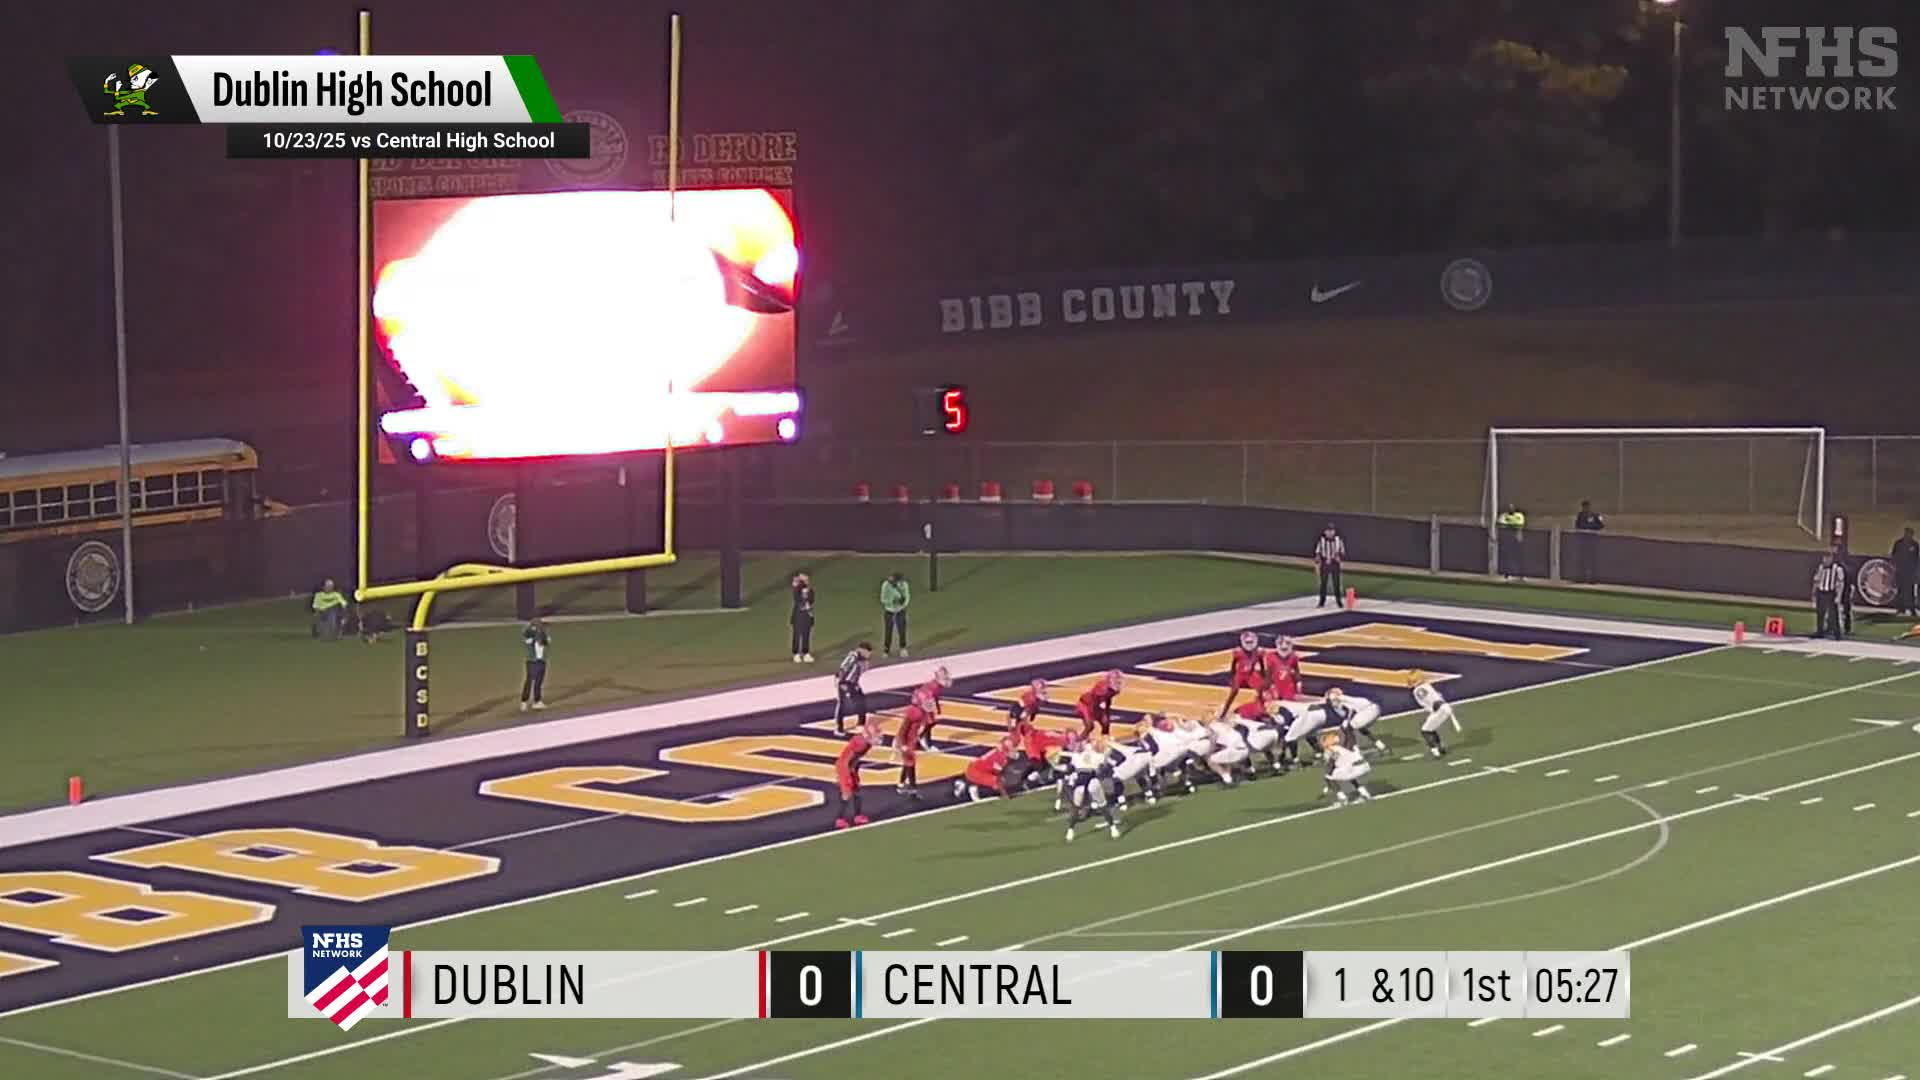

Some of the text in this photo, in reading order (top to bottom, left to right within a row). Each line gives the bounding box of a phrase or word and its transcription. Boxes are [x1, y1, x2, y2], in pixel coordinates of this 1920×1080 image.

[694, 132, 797, 162] DEFORE
[941, 279, 1236, 332] BIBB COUNTY
[944, 392, 961, 428] 5
